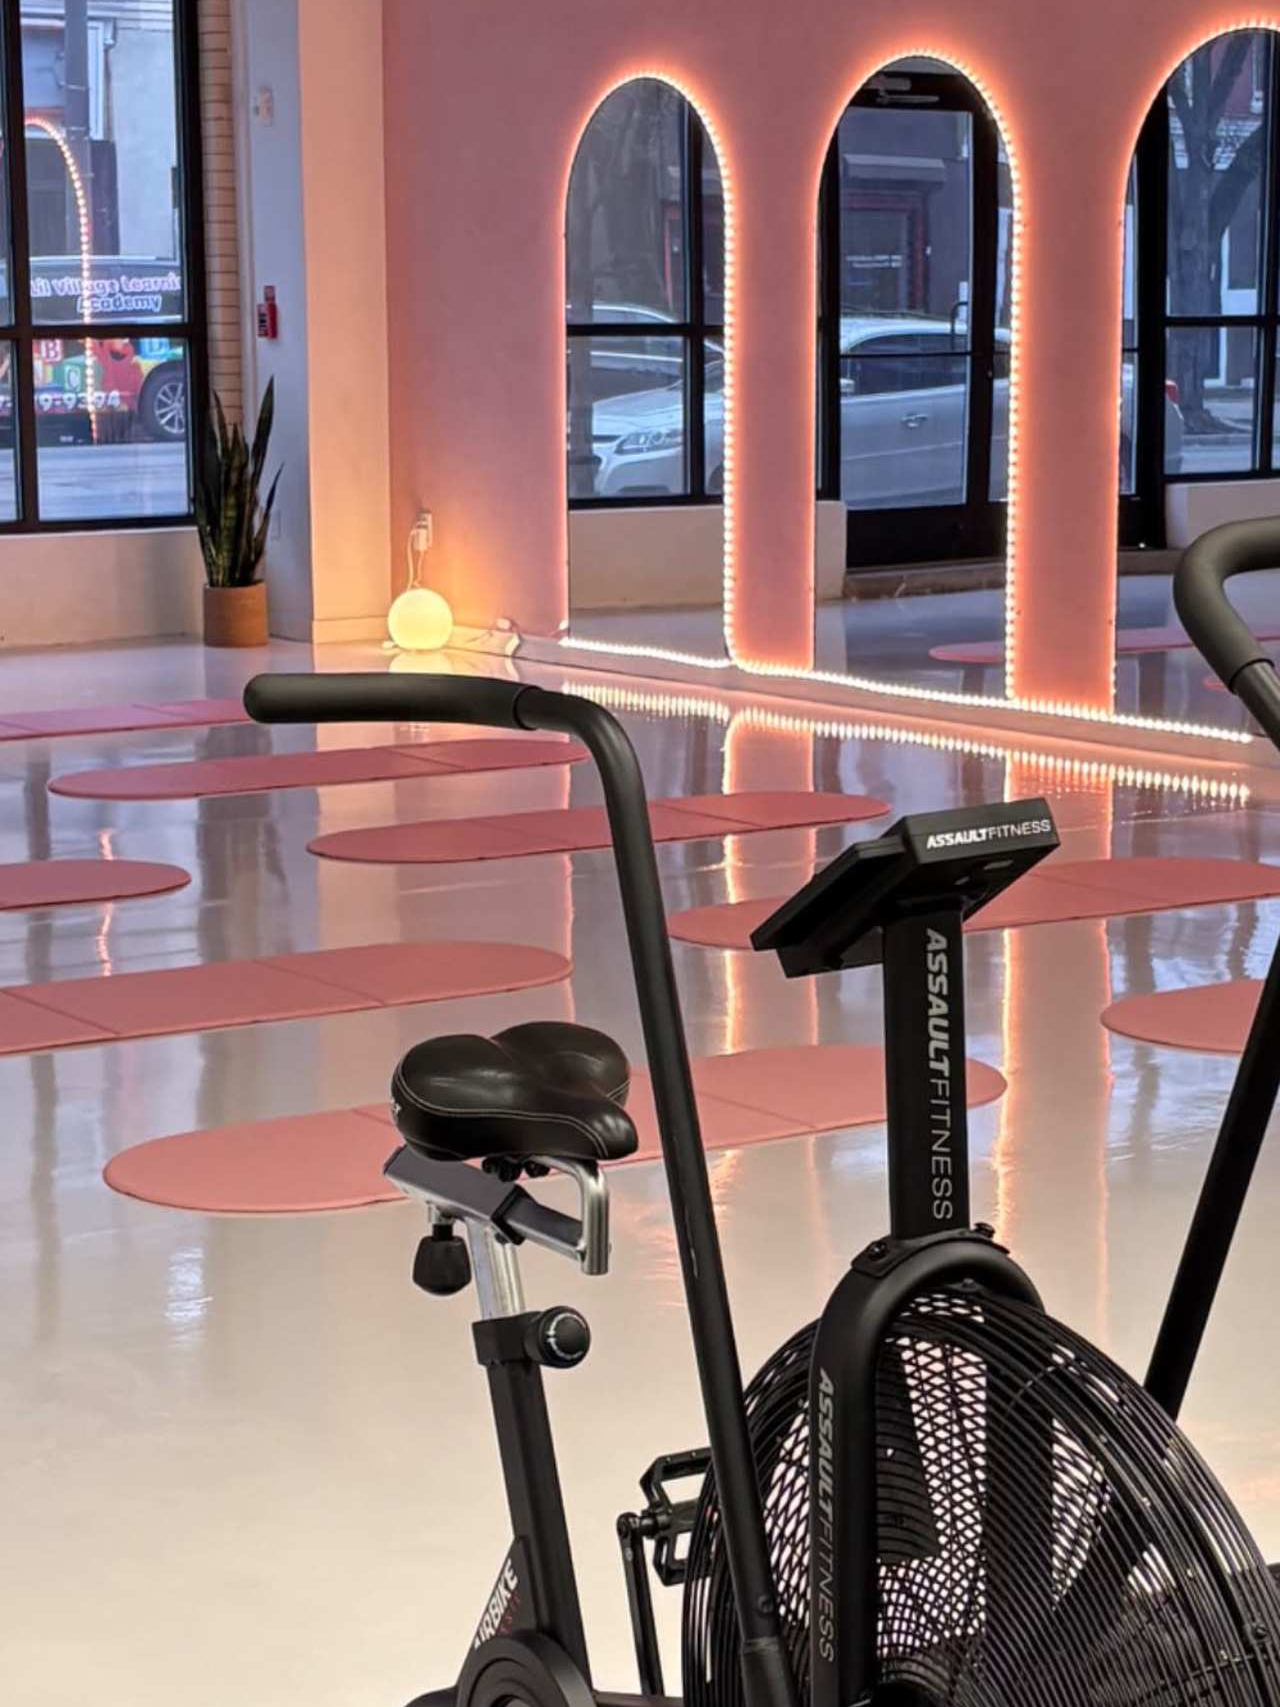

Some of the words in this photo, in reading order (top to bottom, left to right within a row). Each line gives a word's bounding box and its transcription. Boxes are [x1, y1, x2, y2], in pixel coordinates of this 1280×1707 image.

[927, 818, 1052, 849] ASSAULTFITNESS
[925, 928, 953, 1220] ASSAULTFITNESS
[819, 1368, 835, 1662] ASSAULTFITNESS
